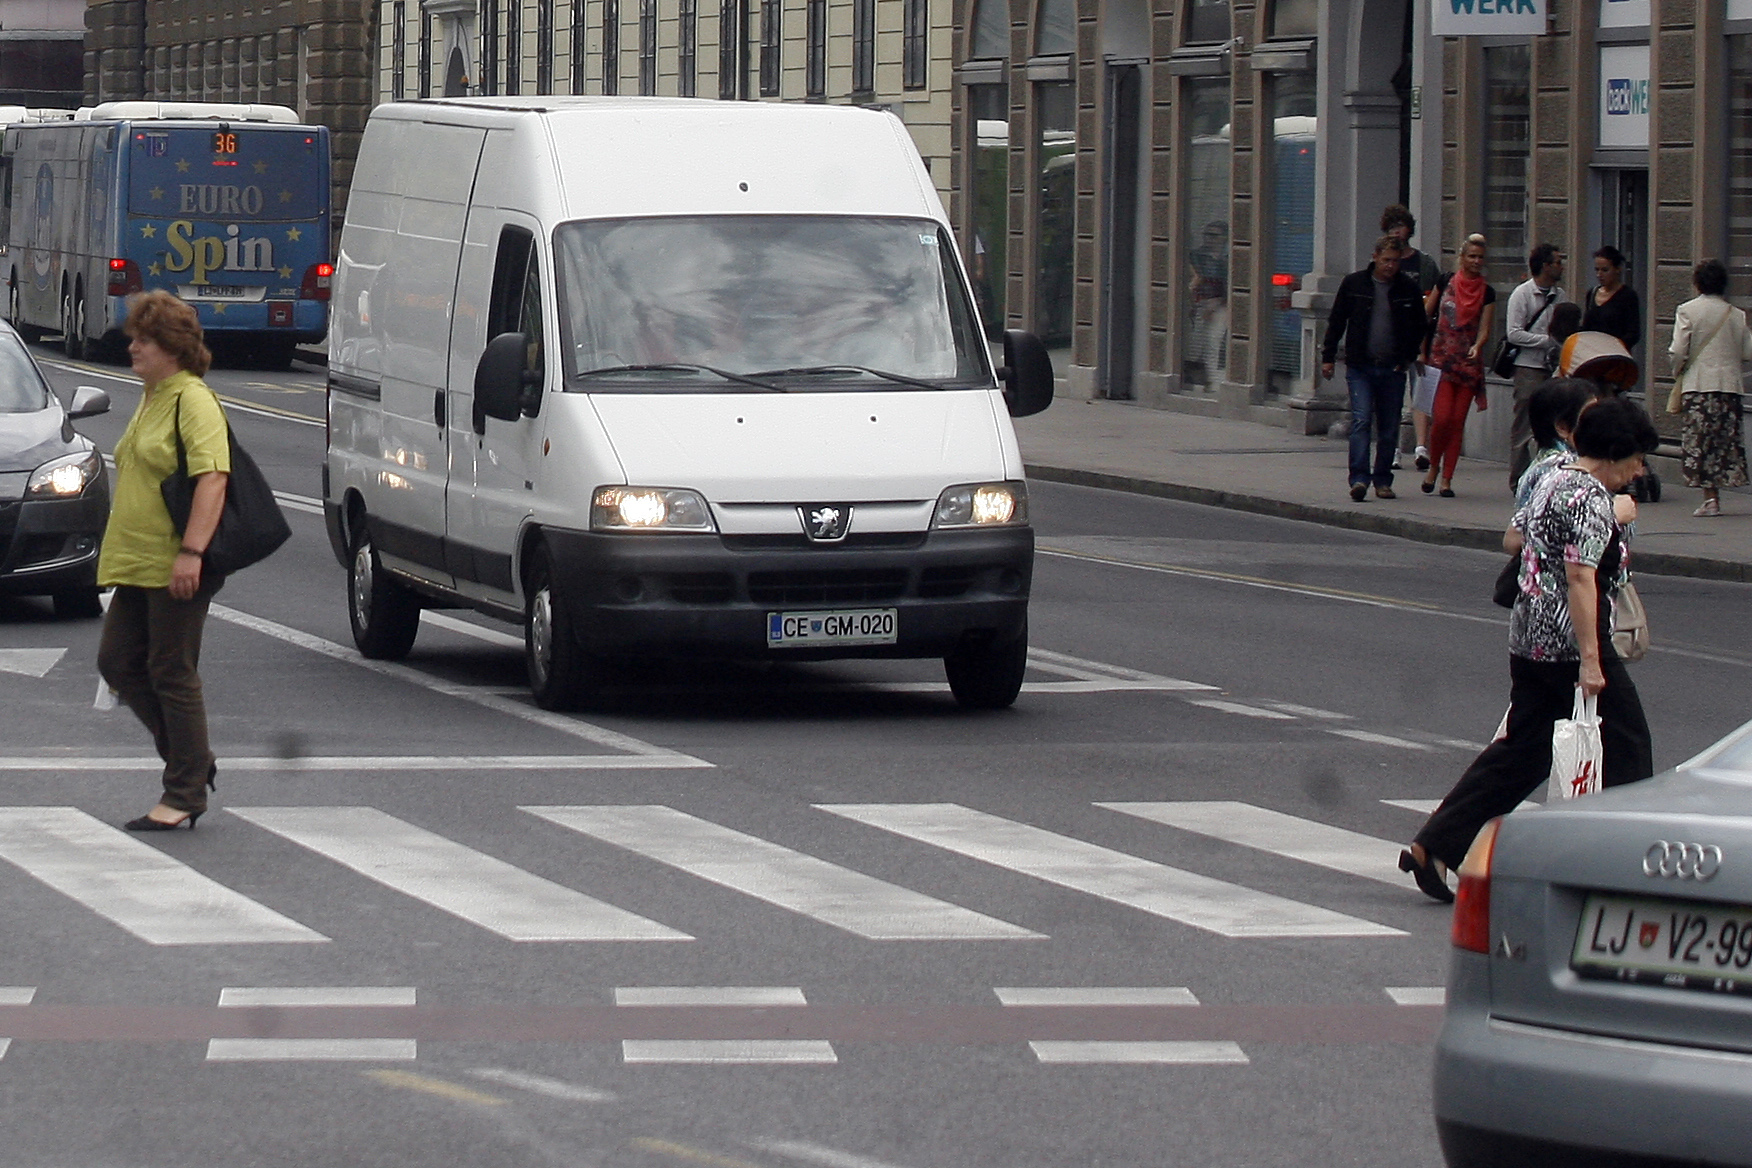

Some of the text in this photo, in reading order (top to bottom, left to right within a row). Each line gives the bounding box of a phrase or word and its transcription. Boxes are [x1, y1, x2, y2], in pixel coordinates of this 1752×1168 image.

[1608, 80, 1650, 115] back WE
[214, 133, 237, 154] 3G
[179, 184, 264, 214] EURO
[165, 220, 275, 284] Spin
[783, 614, 893, 637] CE GM-020
[1590, 906, 1752, 968] LJ V2-99
